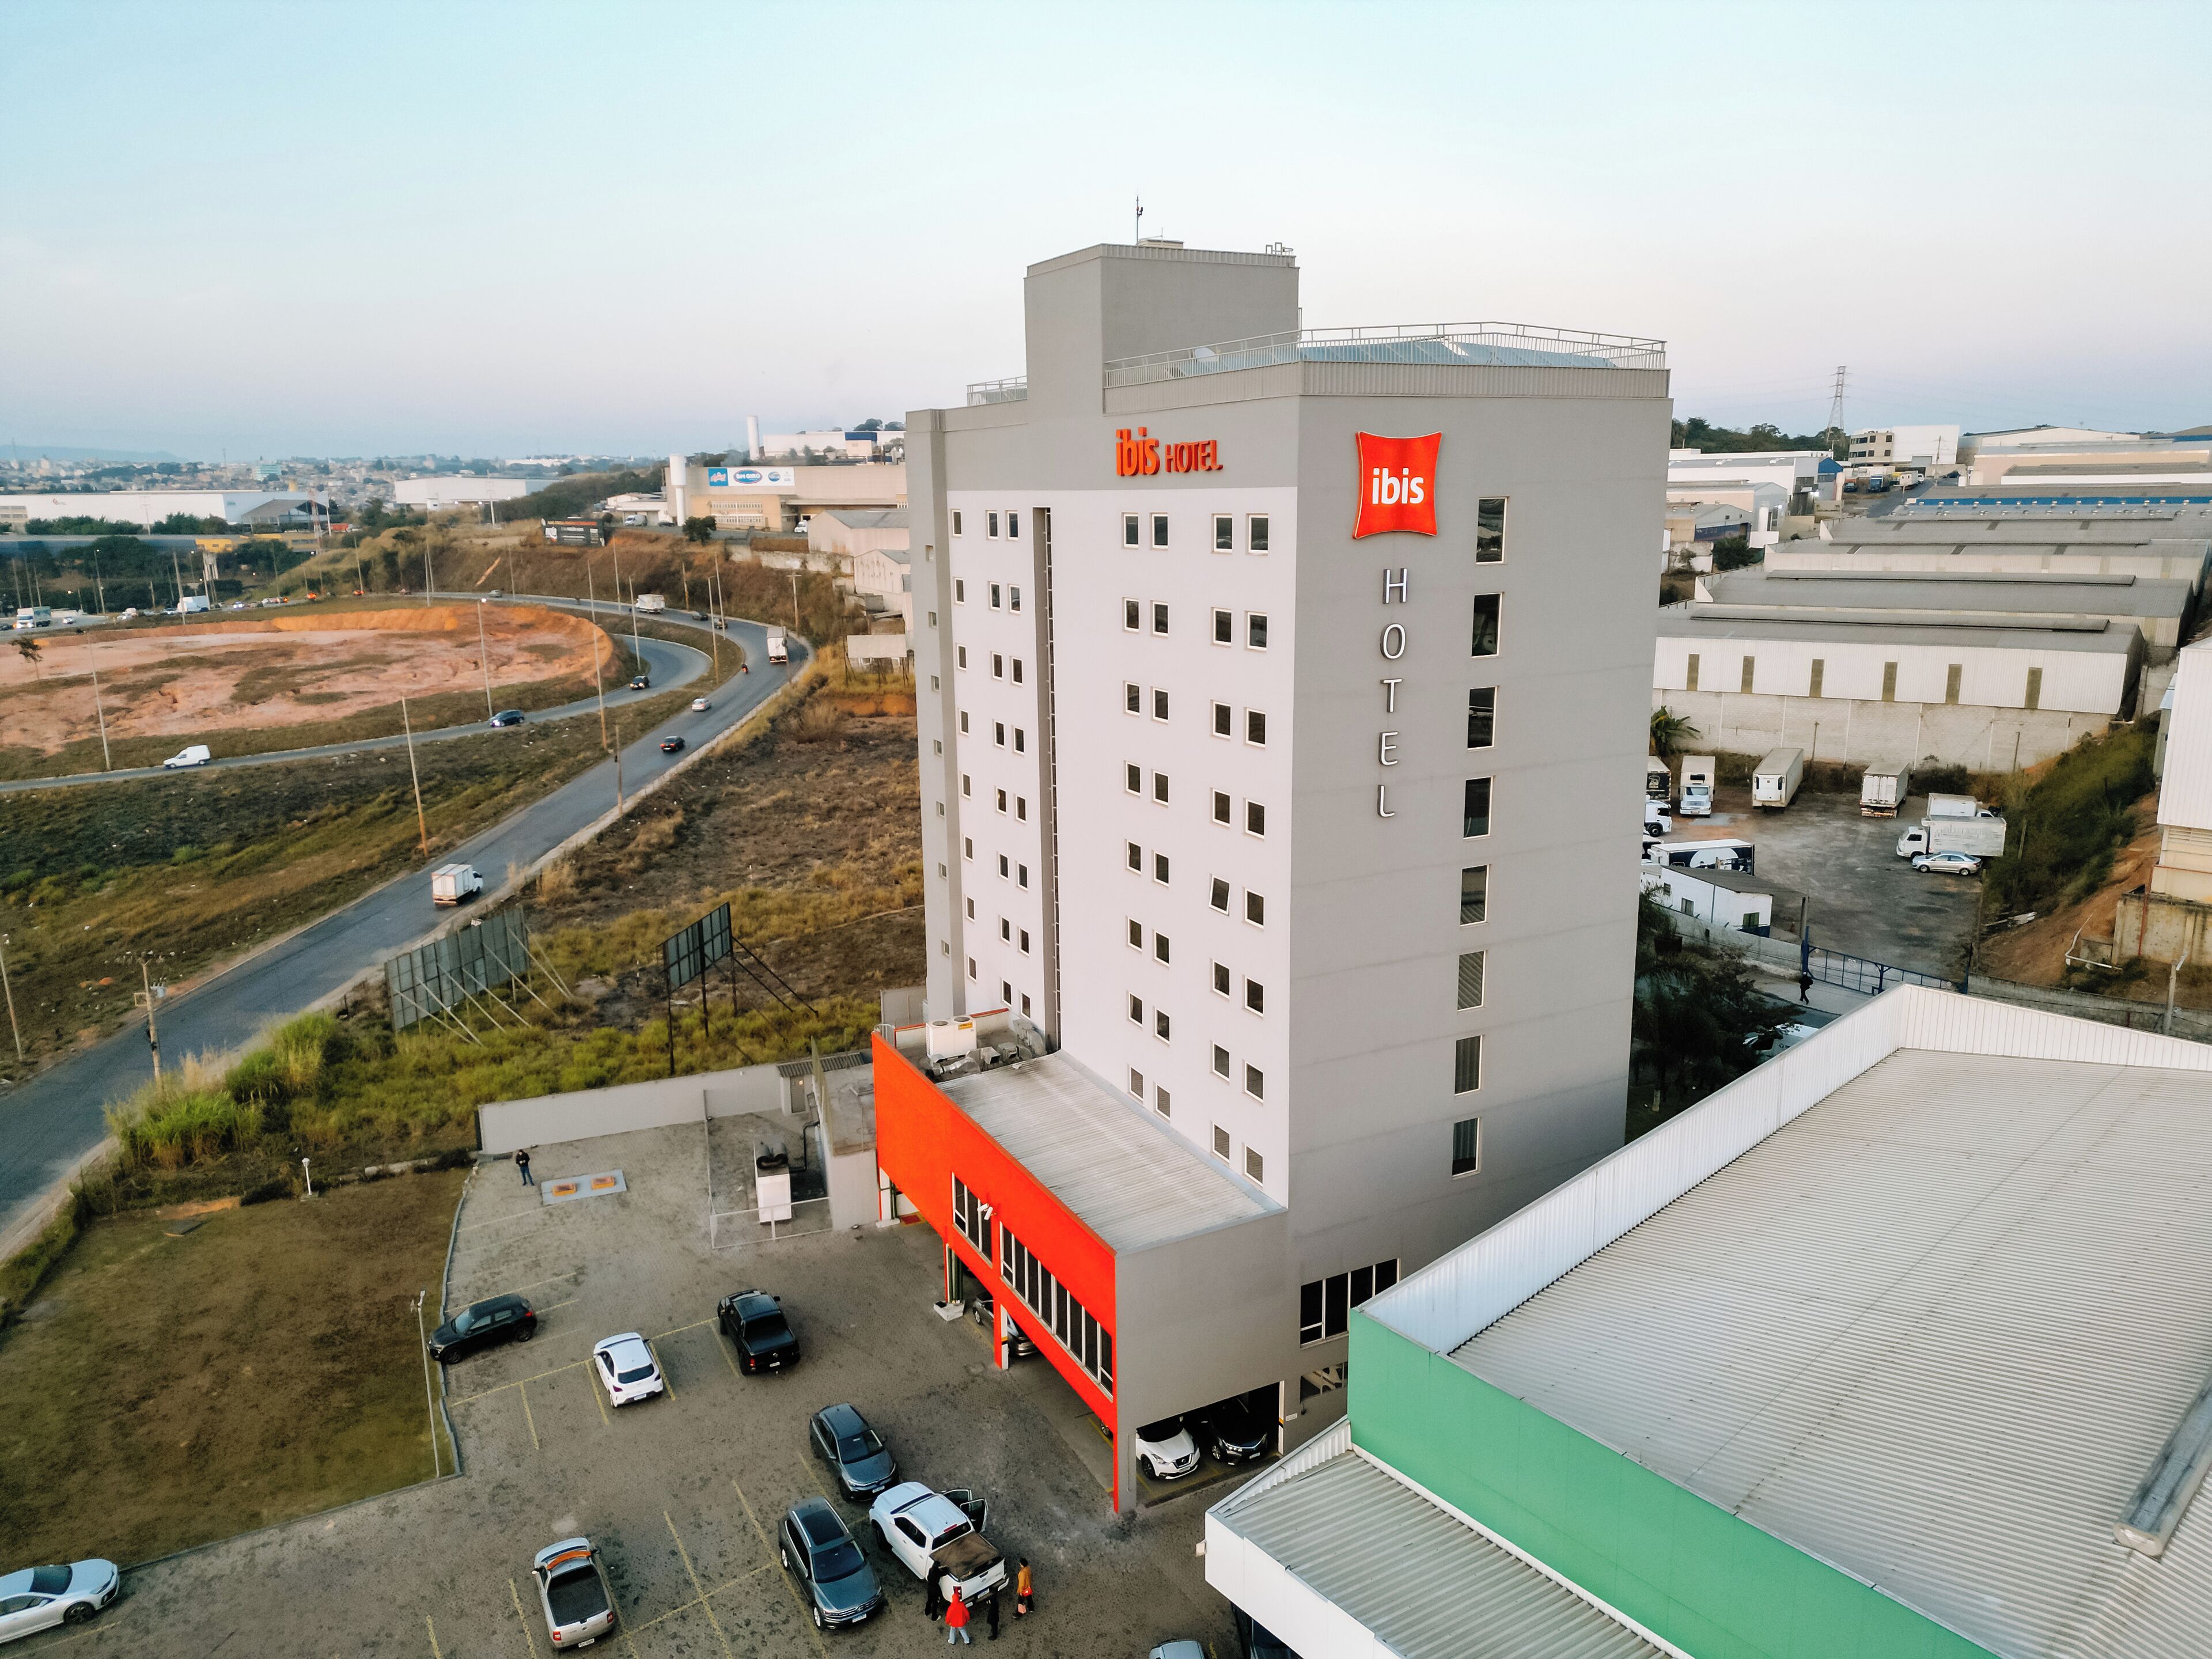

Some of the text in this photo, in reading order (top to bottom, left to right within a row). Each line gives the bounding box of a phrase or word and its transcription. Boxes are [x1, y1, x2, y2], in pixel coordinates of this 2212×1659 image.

[1116, 426, 1224, 476] ibis HOTEL
[1372, 467, 1425, 505] ibis
[1377, 567, 1407, 818] HOTEL
